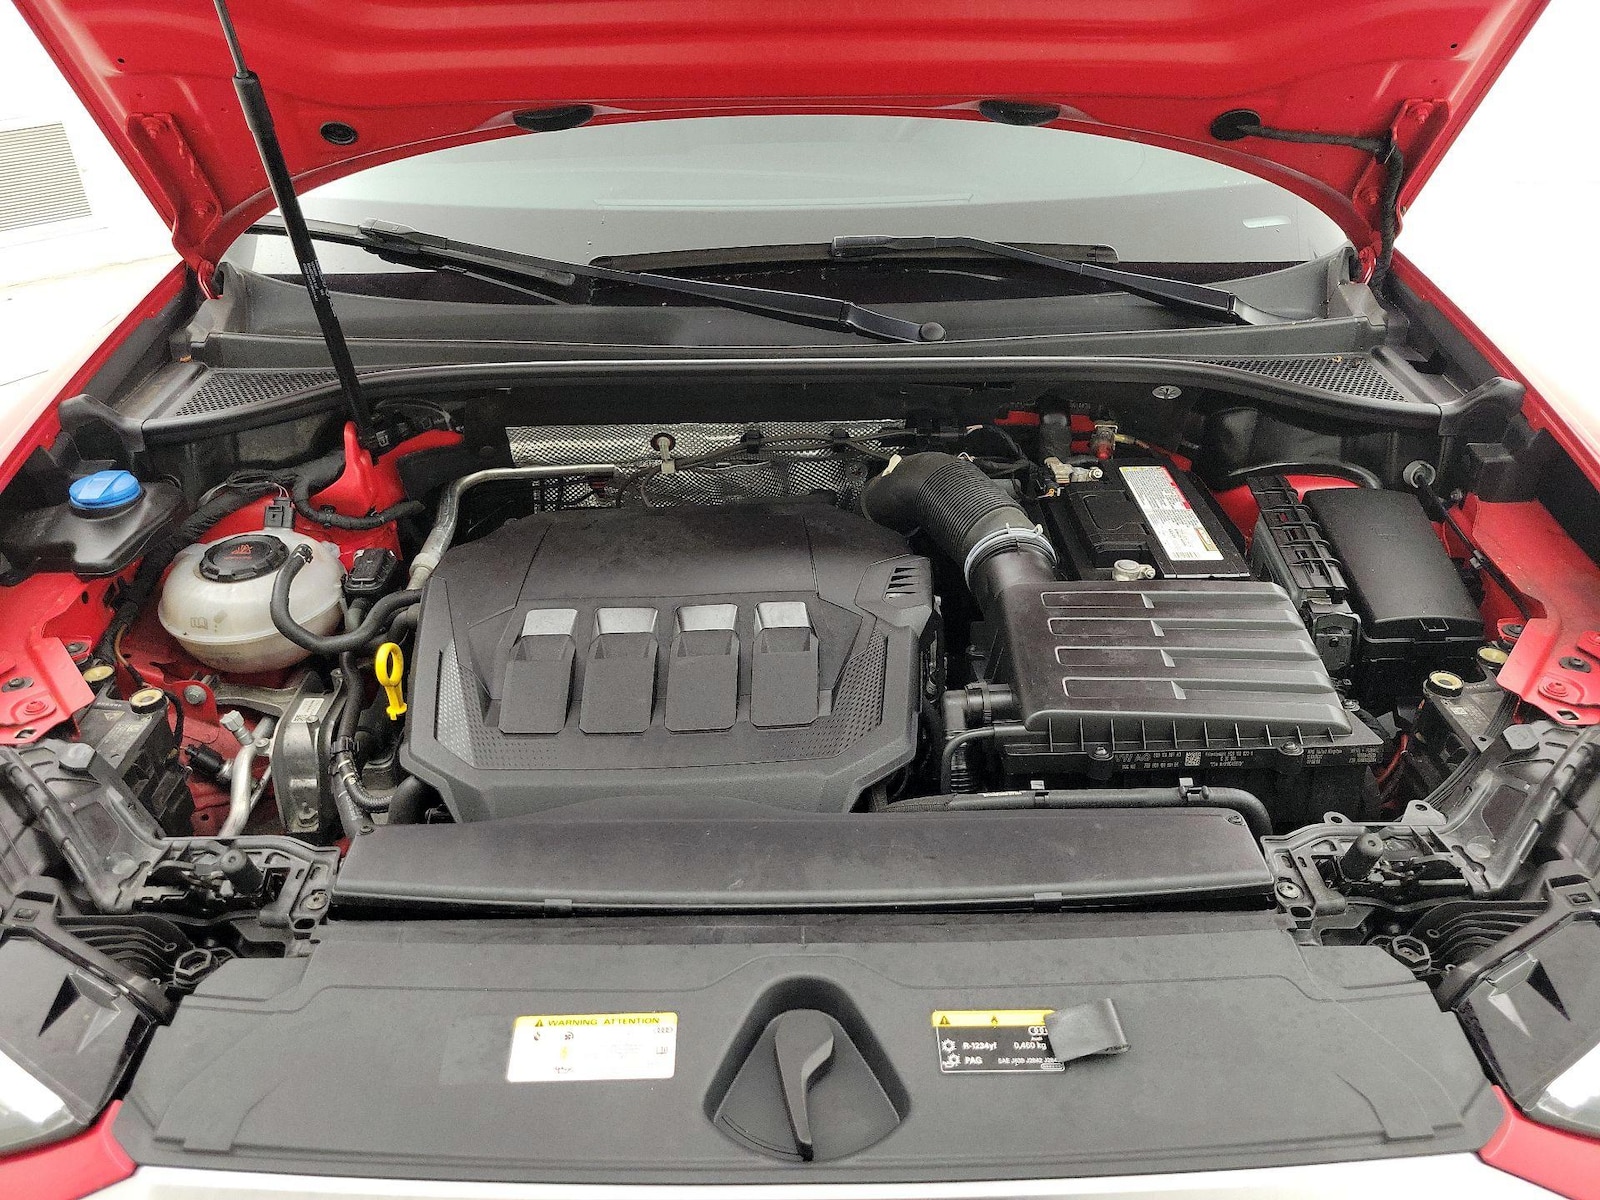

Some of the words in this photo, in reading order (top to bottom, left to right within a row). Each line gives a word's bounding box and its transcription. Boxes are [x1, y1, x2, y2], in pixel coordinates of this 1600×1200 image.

[1115, 754, 1133, 762] VW
[548, 1017, 598, 1026] WARNING
[603, 1017, 661, 1026] ATTENTION
[962, 1042, 997, 1051] R-1234yf
[1036, 1041, 1047, 1051] kg
[964, 1056, 983, 1065] PAG
